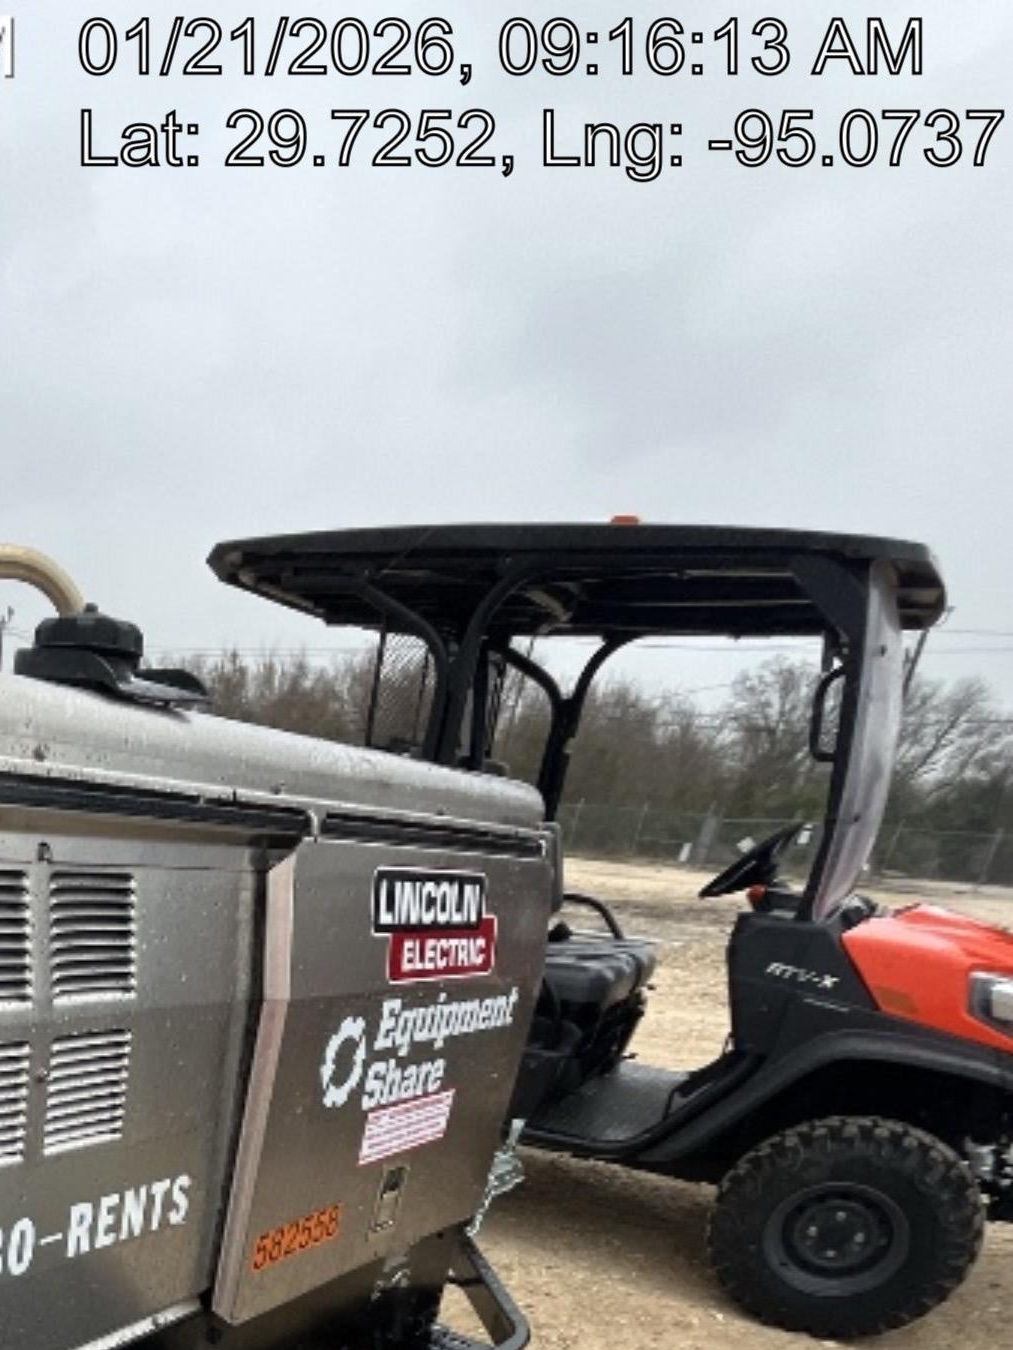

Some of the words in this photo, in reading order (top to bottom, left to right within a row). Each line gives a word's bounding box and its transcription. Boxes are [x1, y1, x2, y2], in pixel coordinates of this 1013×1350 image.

[379, 878, 481, 926] LINCOLN
[400, 937, 487, 973] ELECTRIC
[374, 986, 519, 1057] Equipment
[362, 1057, 447, 1110] Share
[252, 1204, 340, 1271] 582558
